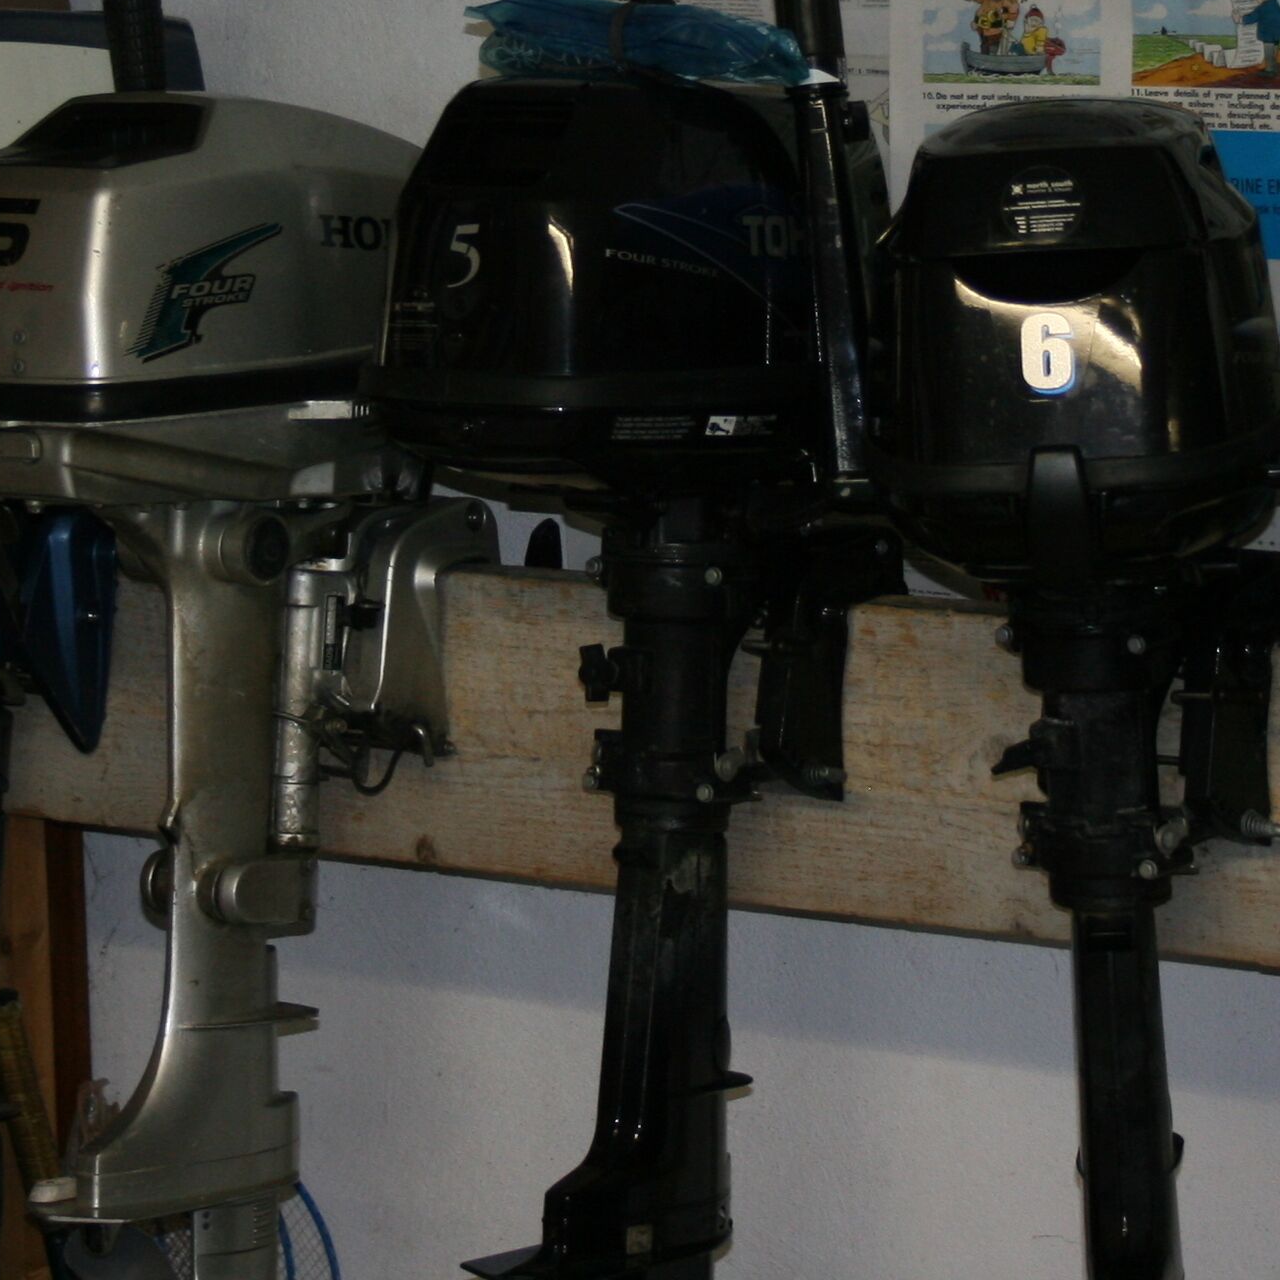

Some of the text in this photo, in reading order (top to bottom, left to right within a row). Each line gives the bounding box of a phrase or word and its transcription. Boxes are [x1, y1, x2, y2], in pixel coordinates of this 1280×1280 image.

[1236, 91, 1270, 100] planned
[446, 224, 480, 288] 5
[604, 248, 656, 266] FOUR
[171, 276, 254, 300] FOUR
[182, 291, 248, 308] STROKE
[1020, 312, 1076, 396] 6
